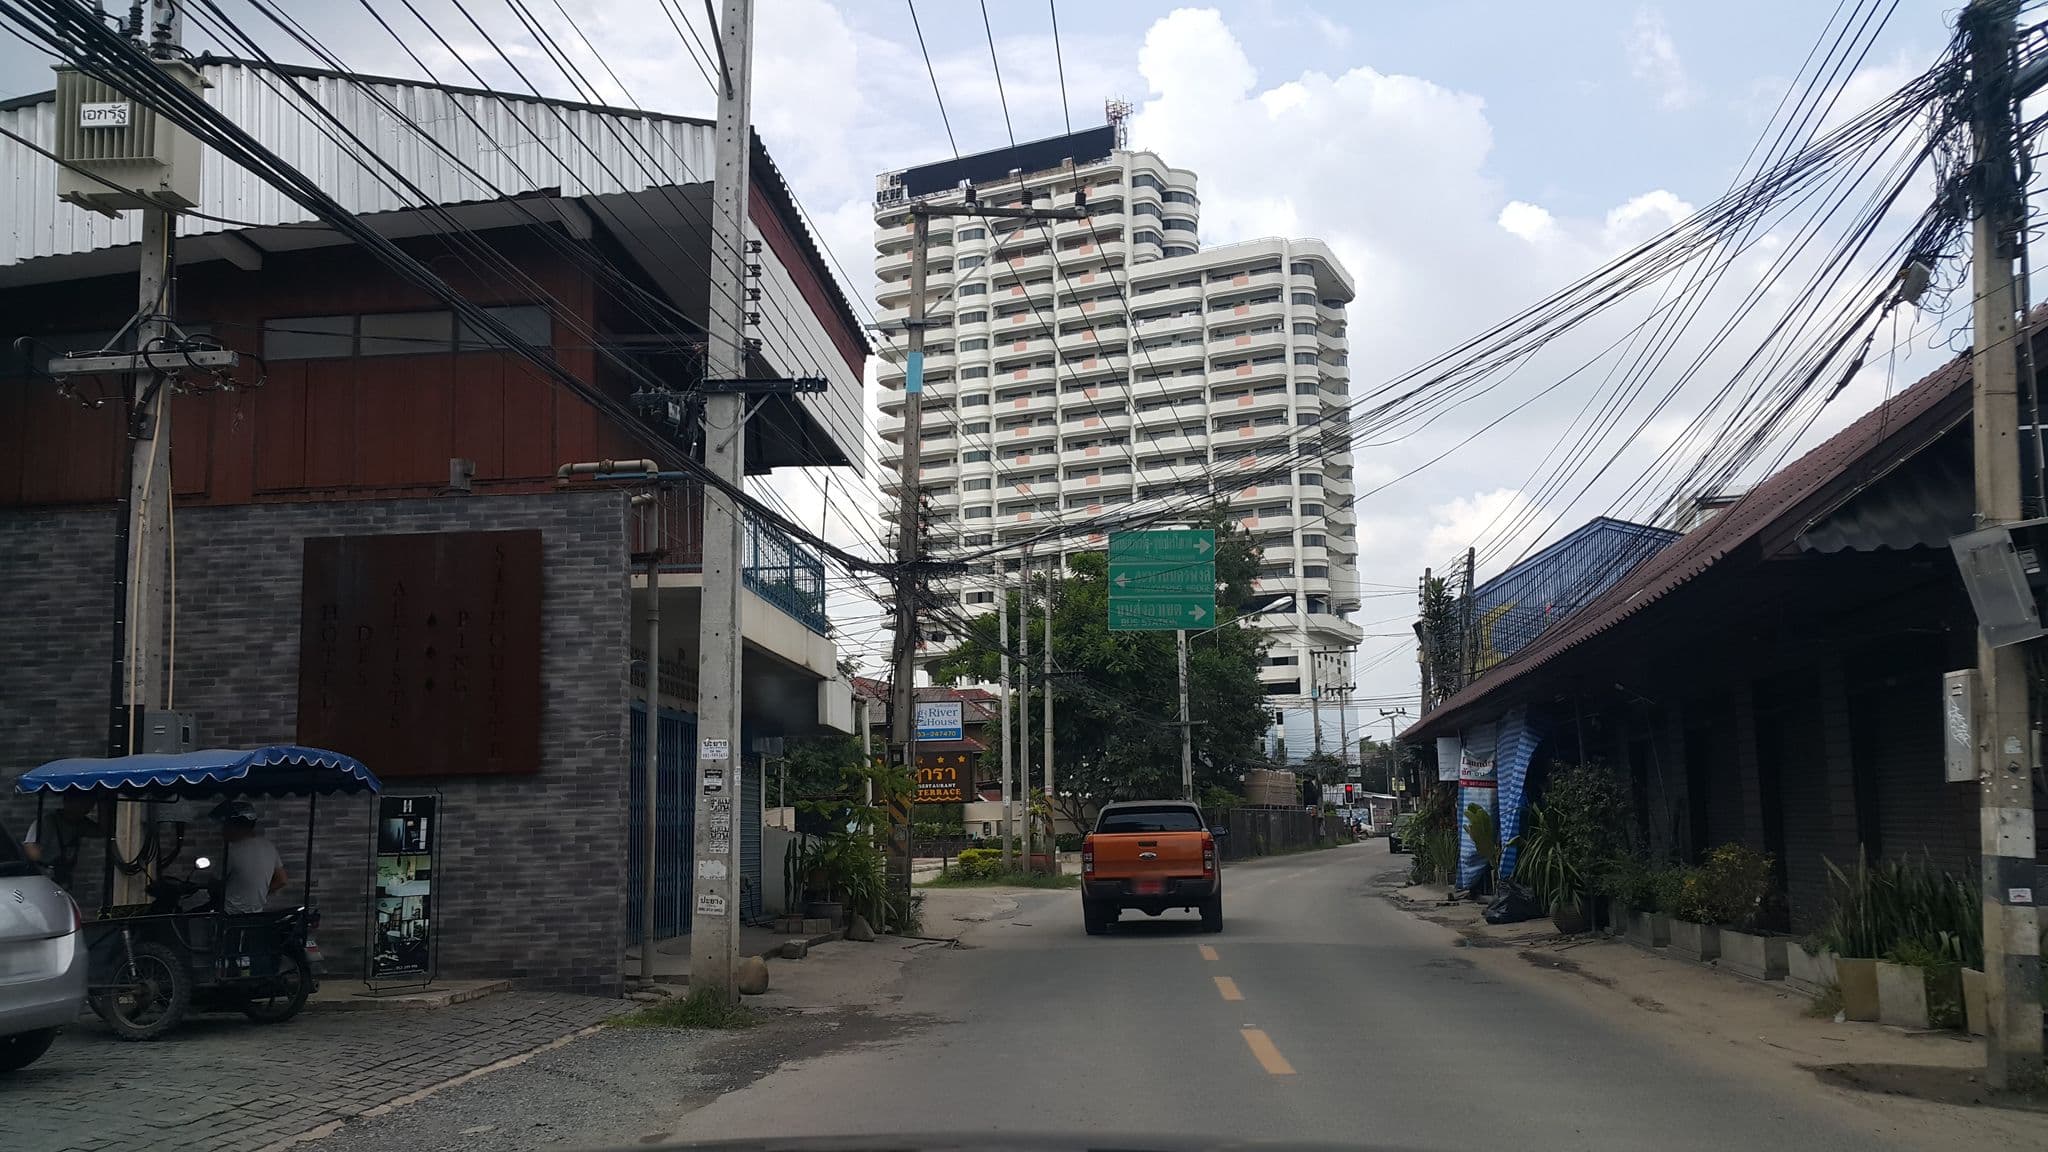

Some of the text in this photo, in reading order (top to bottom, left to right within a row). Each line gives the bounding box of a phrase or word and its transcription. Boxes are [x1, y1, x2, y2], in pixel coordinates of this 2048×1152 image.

[82, 104, 127, 125] เอกรัฐ
[929, 708, 959, 717] River
[927, 718, 958, 726] House
[917, 788, 961, 796] TERRACE
[700, 896, 723, 905] ปะยาง
